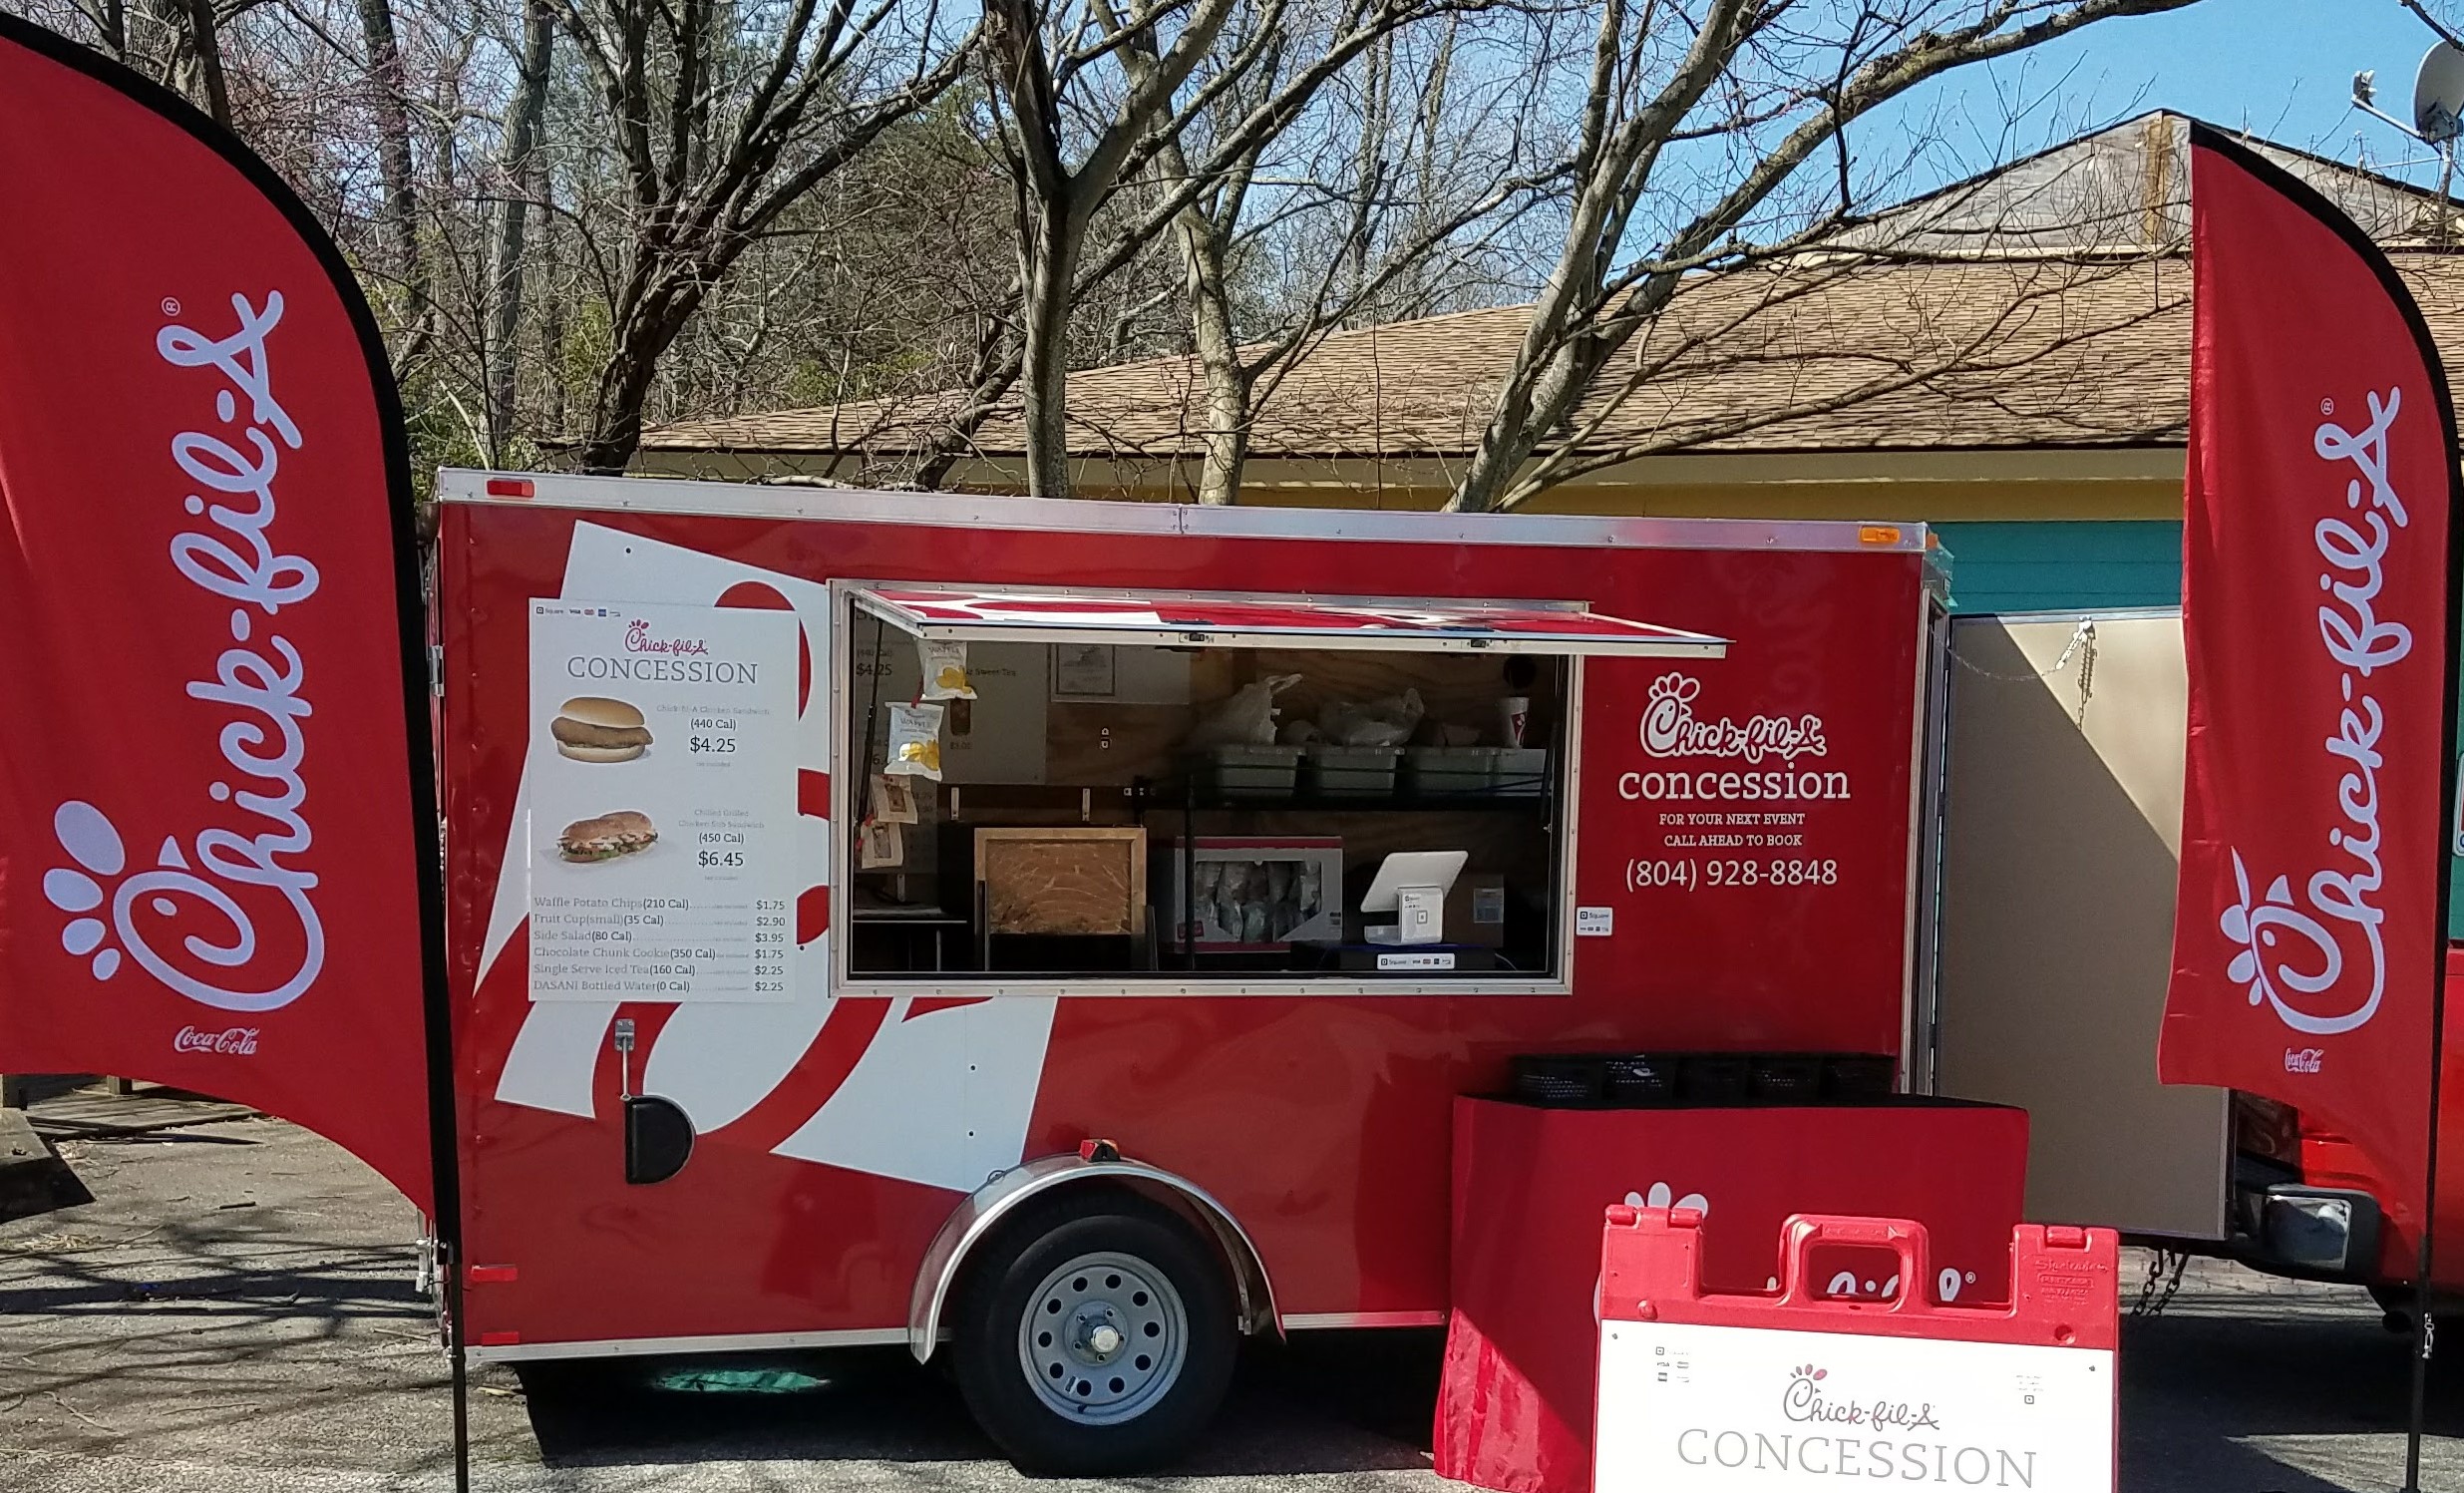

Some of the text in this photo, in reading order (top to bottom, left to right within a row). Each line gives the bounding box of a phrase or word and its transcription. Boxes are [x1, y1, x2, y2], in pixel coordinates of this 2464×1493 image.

[624, 622, 709, 657] Chick-fil-A
[112, 289, 325, 1012] Chick-fil-A
[567, 656, 759, 685] CONCESSION
[856, 662, 892, 676] $425
[2246, 386, 2413, 1034] Chick-fil-A
[690, 718, 737, 731] (440 Cal)
[1640, 683, 1827, 764] Chick-fil-A
[690, 734, 736, 754] $4.25
[1617, 761, 1851, 800] concession
[1658, 813, 1806, 826] FOR YOUR NEXT EVENT
[698, 832, 745, 846] (450 Cal)
[1663, 835, 1804, 847] CALL AHEAD TO BOOK
[698, 849, 744, 869] $6.45
[1625, 858, 1839, 893] (804) 928-8848
[756, 900, 786, 911] $1.75
[756, 916, 786, 927] $2.90
[755, 933, 785, 943] $3.95
[755, 948, 784, 959] $1.75
[754, 964, 784, 975] $2.25
[754, 980, 784, 991] $2.25
[174, 1025, 260, 1055] Coca-Cola
[1783, 1372, 1940, 1432] Chick-fil-A
[1677, 1427, 2037, 1490] CONCESSION
